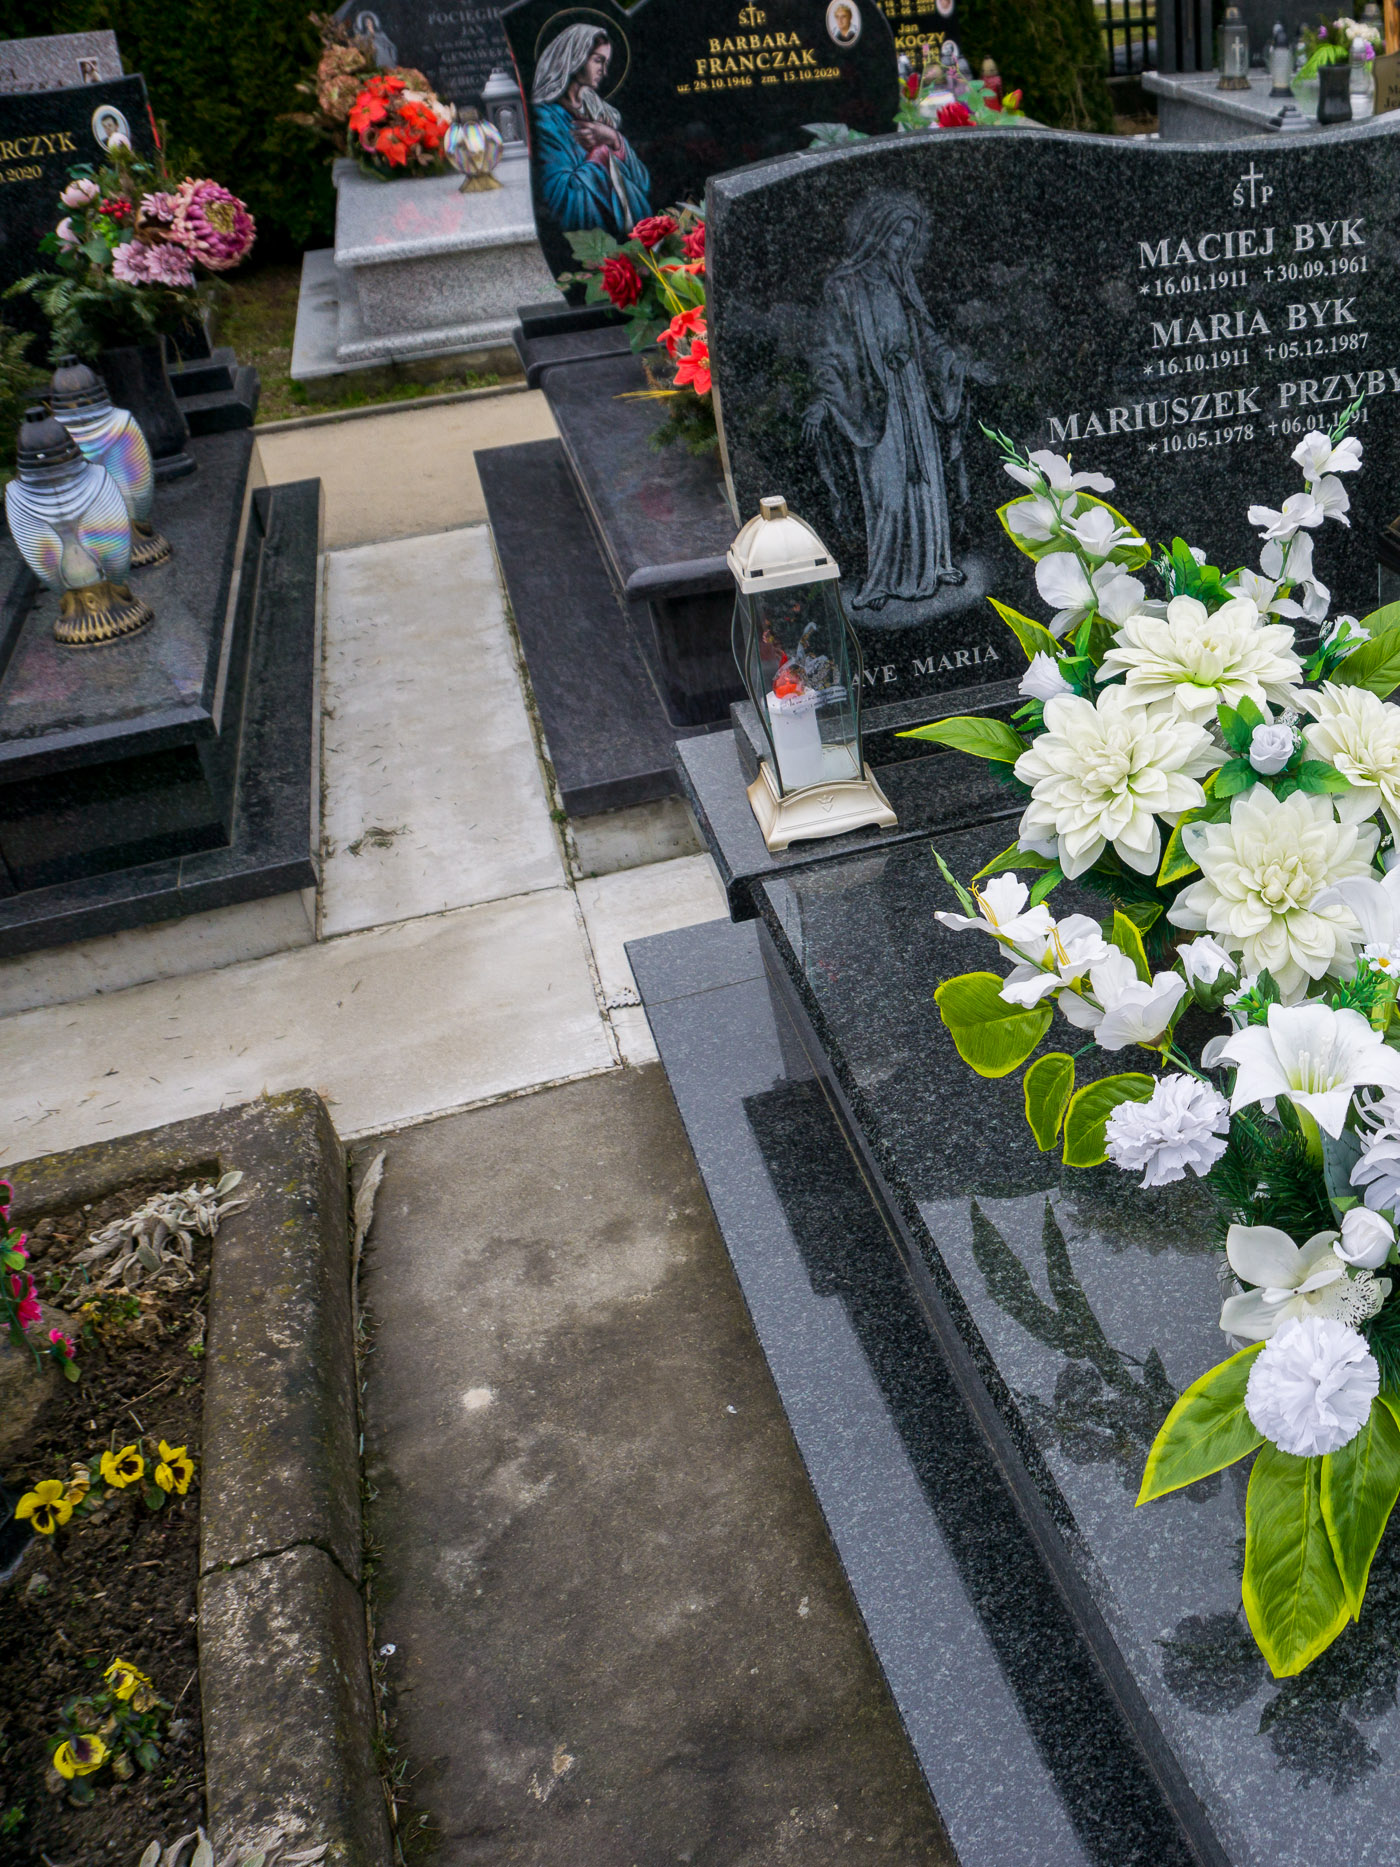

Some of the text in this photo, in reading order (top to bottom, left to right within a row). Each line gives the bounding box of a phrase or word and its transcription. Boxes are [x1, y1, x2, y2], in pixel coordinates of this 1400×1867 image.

[708, 31, 801, 53] BARBARA
[894, 31, 946, 49] KOCZY
[898, 23, 919, 34] Jan
[695, 48, 817, 75] FRANCZAK
[693, 75, 753, 91] 28.10.1946
[760, 74, 780, 85] zm.
[783, 66, 840, 82] 15.10.2020
[0, 131, 77, 161] RCZYK
[1232, 183, 1274, 207] Ś P
[1138, 217, 1366, 270] MACIEJ BYK
[1150, 296, 1358, 350] MARIA BYK
[1046, 386, 1263, 444] MARIUSZEK
[851, 644, 1001, 691] AVE MARIA
